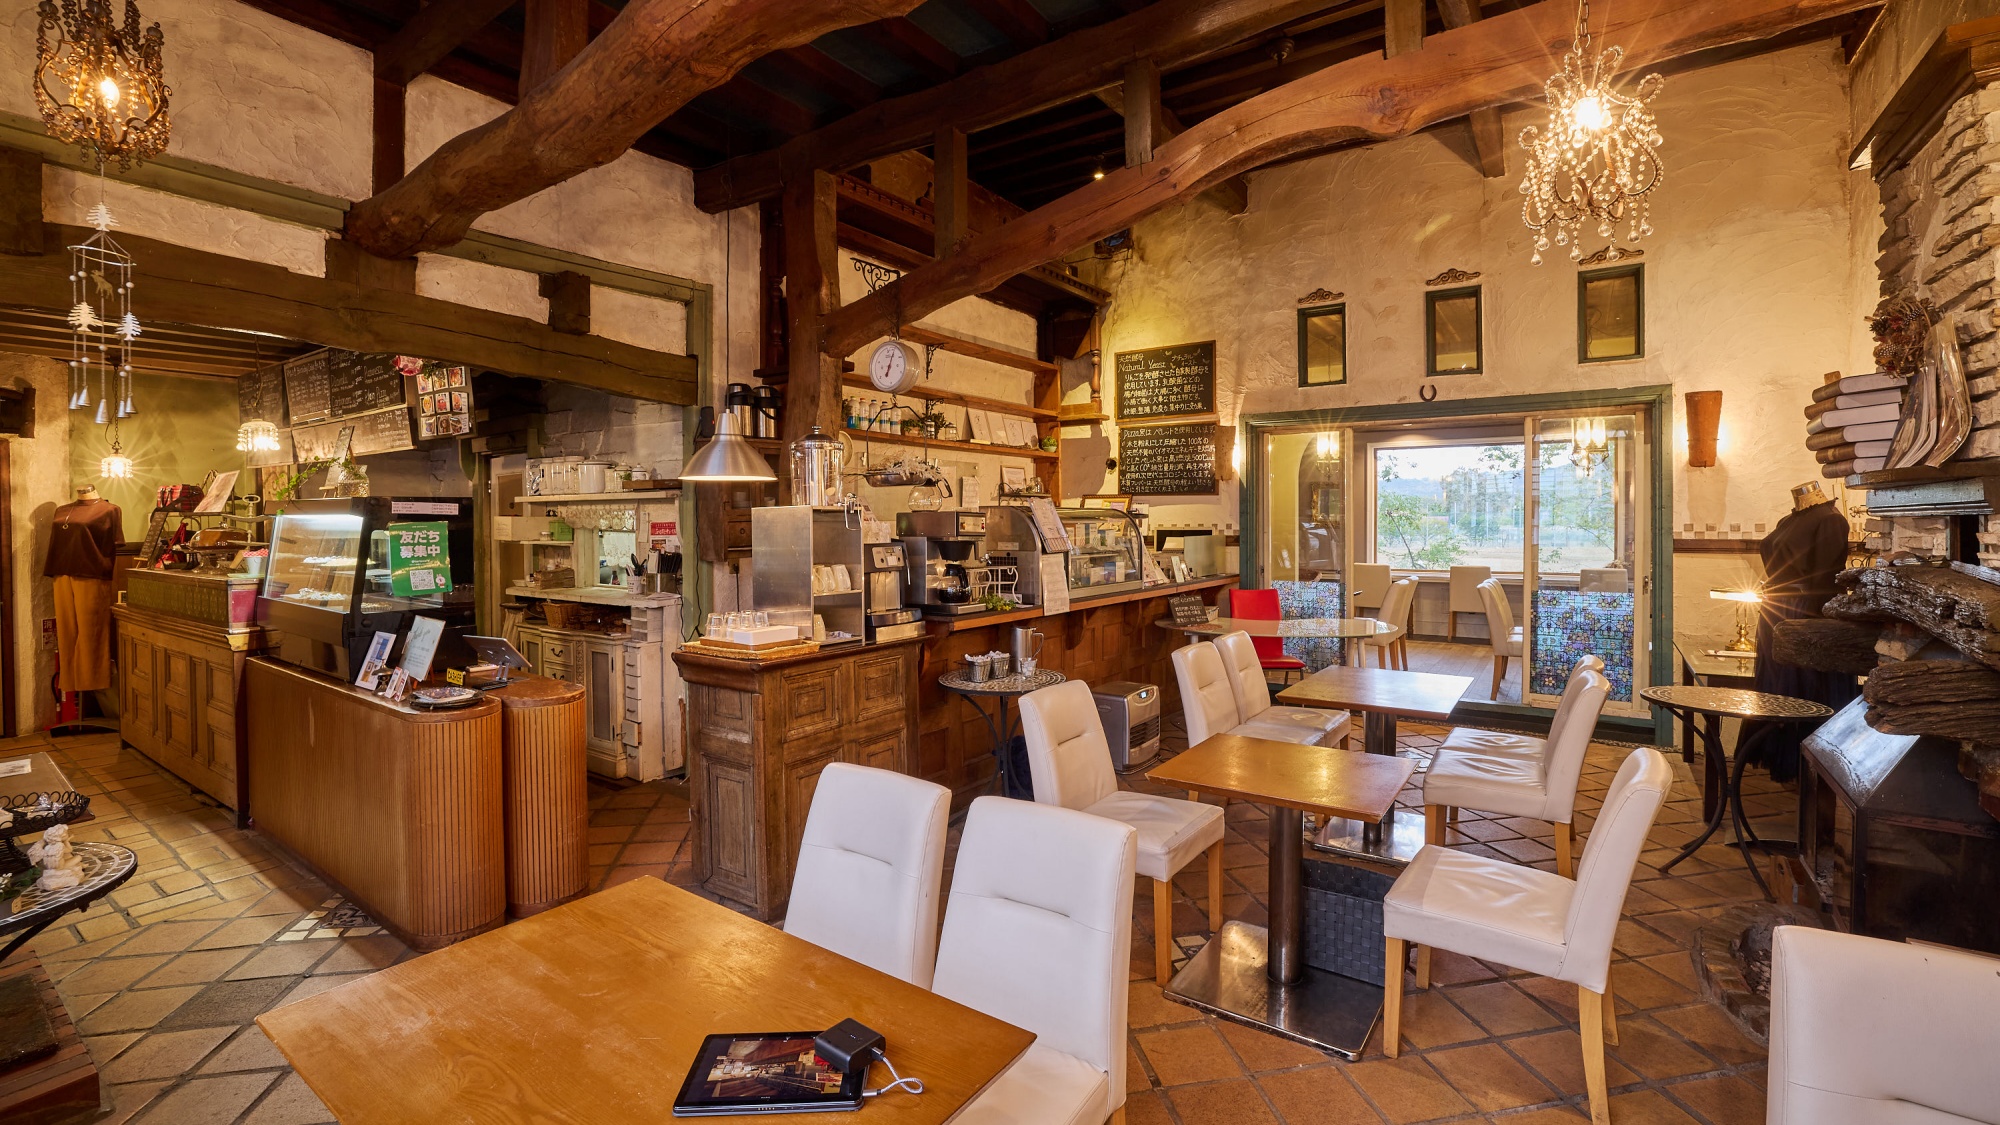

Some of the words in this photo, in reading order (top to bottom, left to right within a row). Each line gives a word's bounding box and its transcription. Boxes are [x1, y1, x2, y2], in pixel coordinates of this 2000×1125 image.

[1118, 353, 1144, 364] 天然酵母
[1172, 353, 1194, 362] ナチュラル
[1118, 360, 1145, 373] Natural
[1148, 359, 1167, 370] Yeast
[400, 530, 440, 544] 友だち
[399, 544, 441, 559] 募集中
